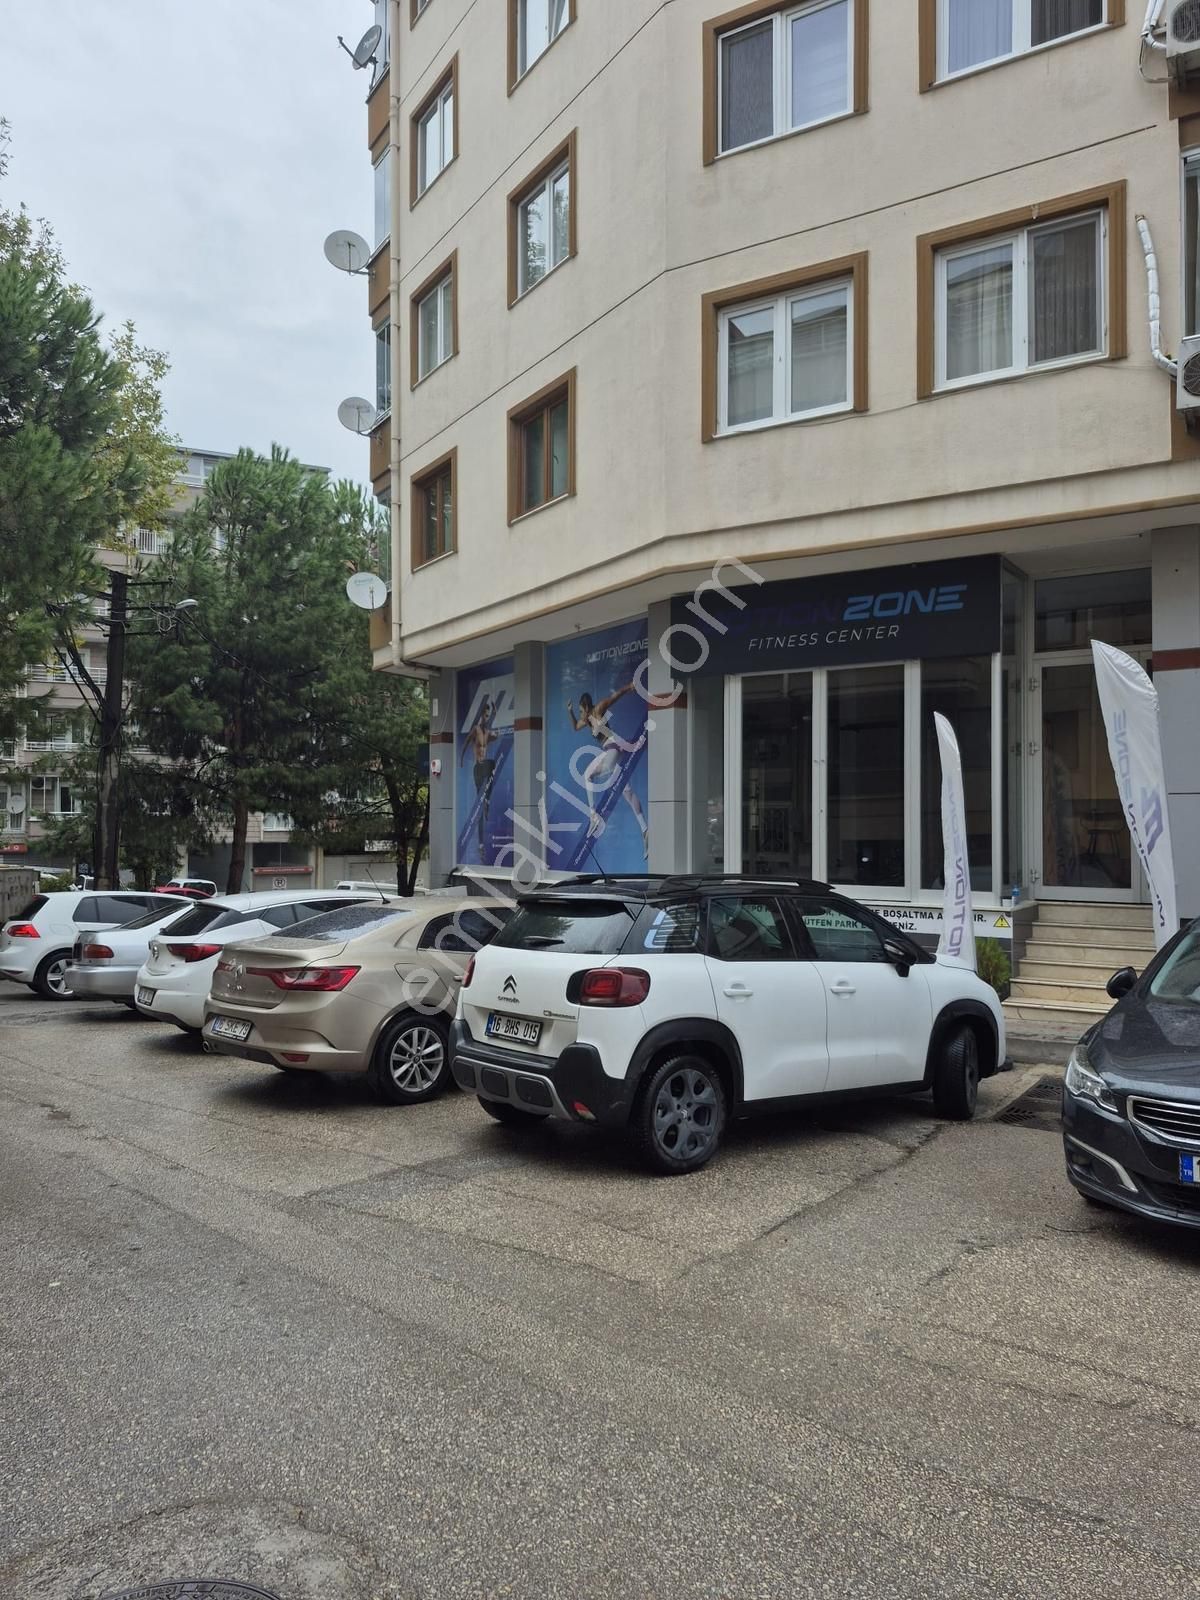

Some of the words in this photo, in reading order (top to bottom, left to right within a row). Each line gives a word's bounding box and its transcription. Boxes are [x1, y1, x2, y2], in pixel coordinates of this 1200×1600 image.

[748, 632, 819, 651] FITNESS
[825, 624, 900, 644] CENTER
[805, 916, 832, 927] ÜTFEN
[835, 918, 857, 929] PARK
[882, 909, 934, 920] BOŞALTMA
[492, 1016, 502, 1032] 16
[504, 1018, 521, 1036] BHS
[523, 1022, 539, 1040] 015
